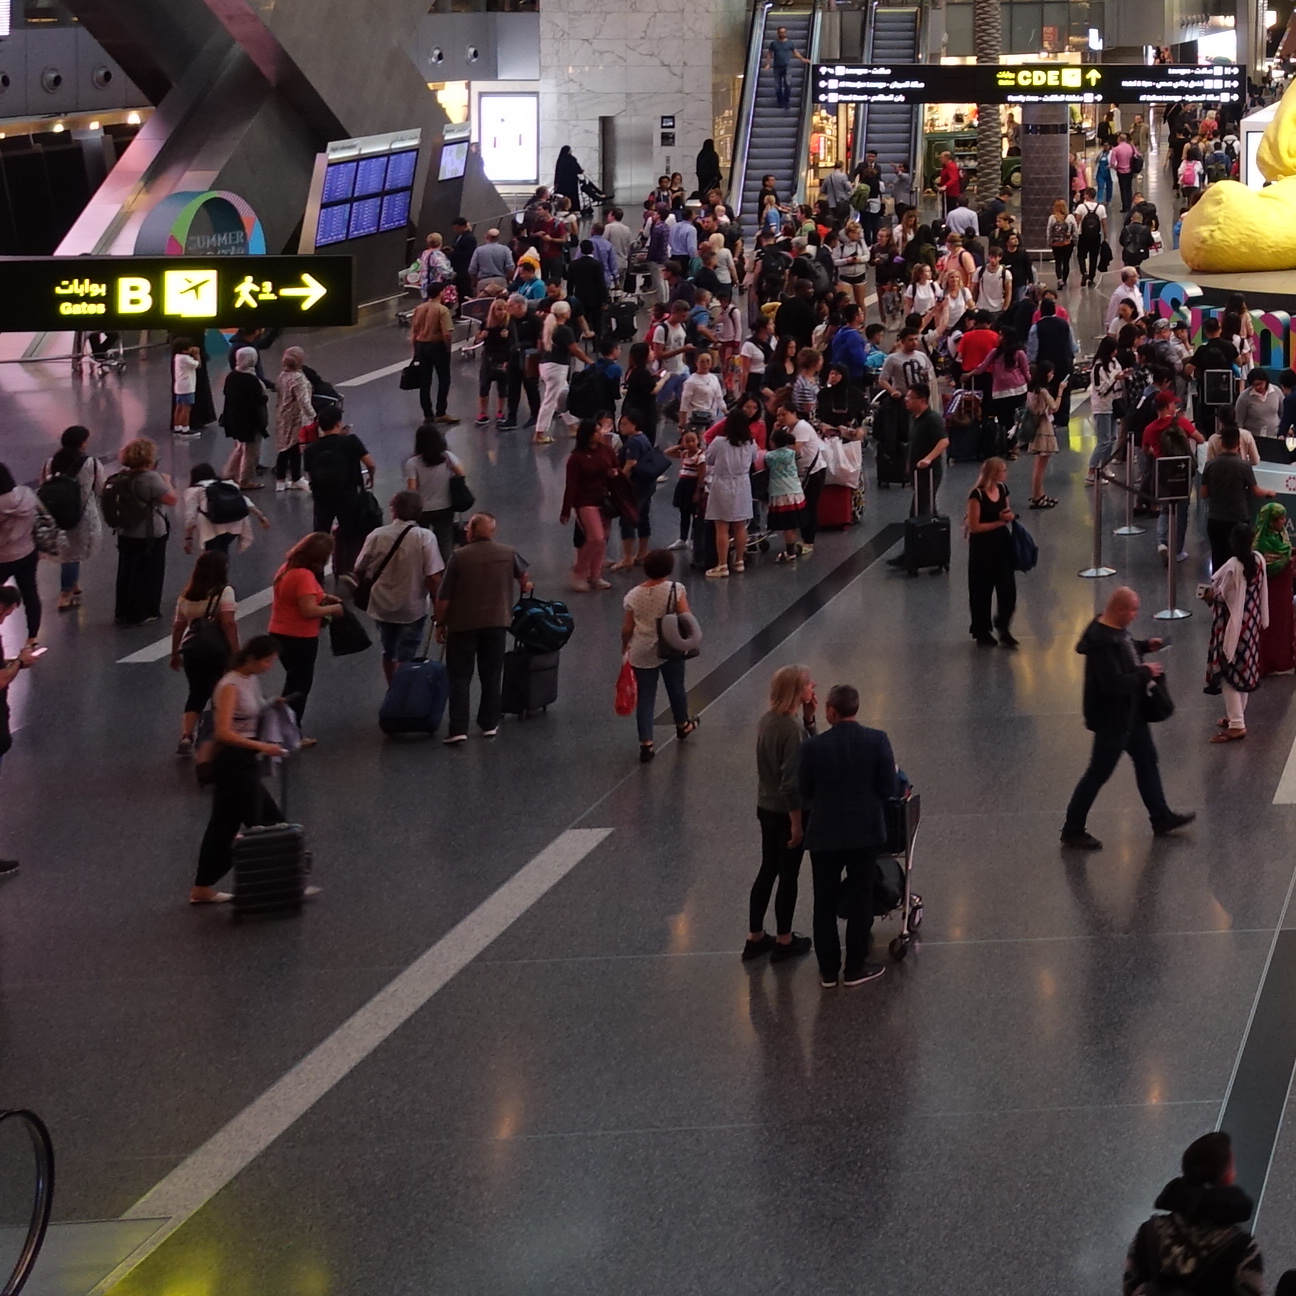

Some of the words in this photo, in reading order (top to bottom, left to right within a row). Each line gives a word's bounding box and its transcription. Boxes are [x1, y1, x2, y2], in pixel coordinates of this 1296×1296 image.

[1017, 70, 1059, 85] CDE
[55, 278, 106, 297] بوابات
[117, 276, 153, 314] B
[59, 301, 106, 315] Gates
